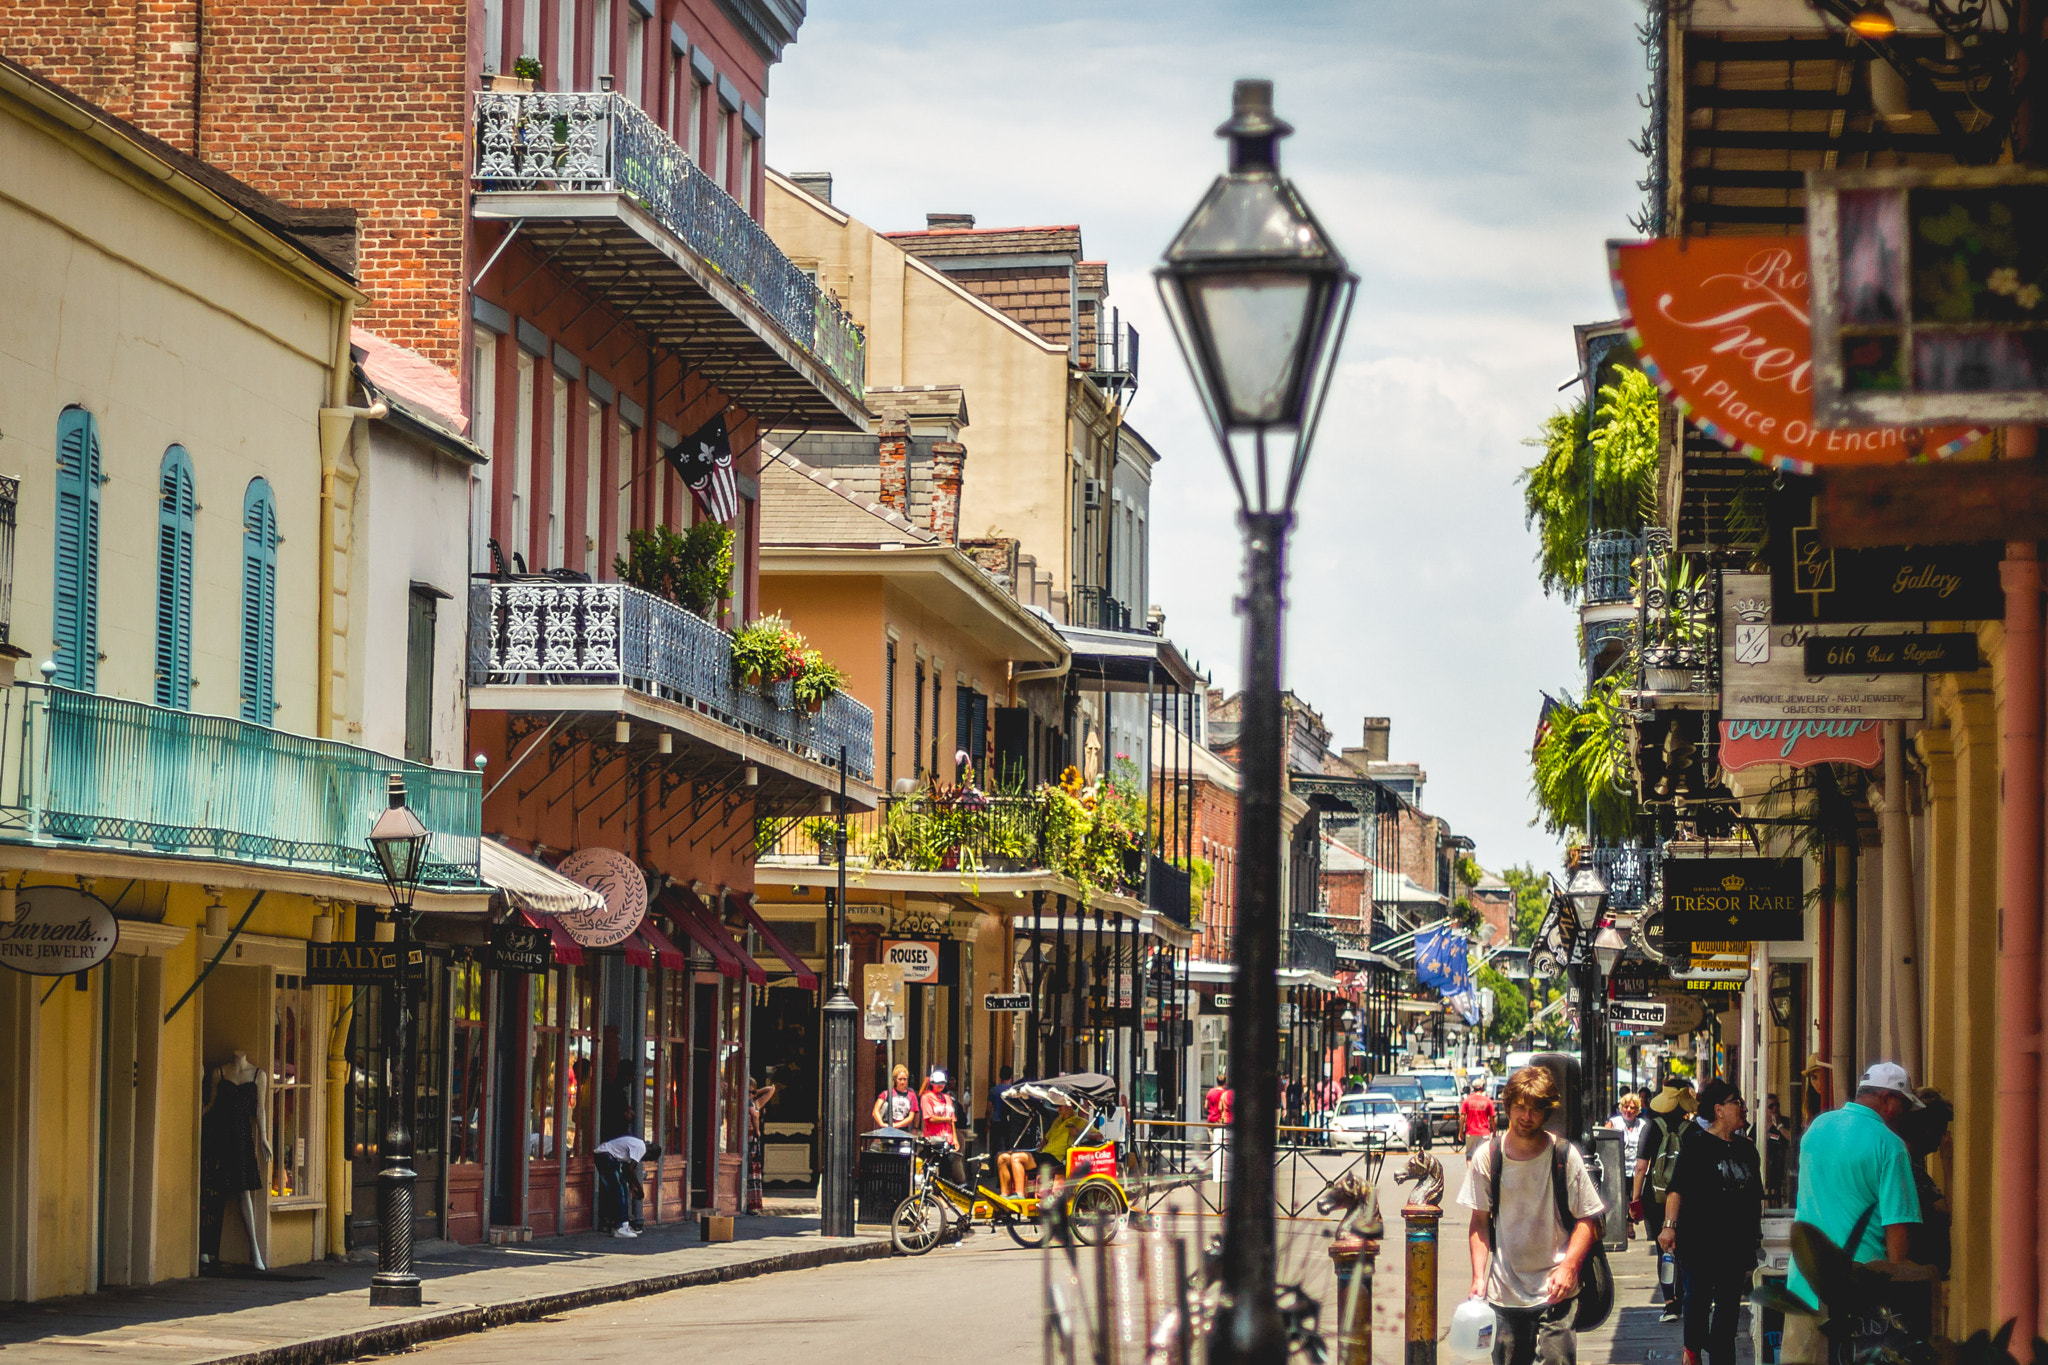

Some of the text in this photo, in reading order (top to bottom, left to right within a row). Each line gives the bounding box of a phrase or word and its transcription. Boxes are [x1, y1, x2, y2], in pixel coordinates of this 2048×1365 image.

[1704, 379, 1778, 438] Place
[1892, 563, 1961, 599] Gallery
[1826, 641, 1946, 666] 616 Rue Royale
[1740, 694, 1783, 704] ANTIQUE
[1785, 694, 1828, 704] JEWELRY
[1838, 694, 1862, 704] NEW
[1863, 694, 1905, 704] JEWELRY
[1782, 705, 1863, 715] OBJECTS OF ART
[1671, 894, 1795, 911] TRÉSOR RARE
[848, 906, 869, 914] PETER
[595, 918, 637, 944] GAMBINO
[1, 943, 97, 960] FINE JEWELRY
[1695, 941, 1747, 953] VOODOO SHOP
[311, 947, 385, 969] ITALY
[496, 950, 543, 964] NAGHI'S
[890, 948, 928, 964] ROUSES
[1687, 980, 1743, 991] BEEF JERKY
[986, 1000, 1029, 1008] St. Peter
[1611, 1008, 1663, 1021] St. Peter
[1095, 1151, 1111, 1159] Coke
